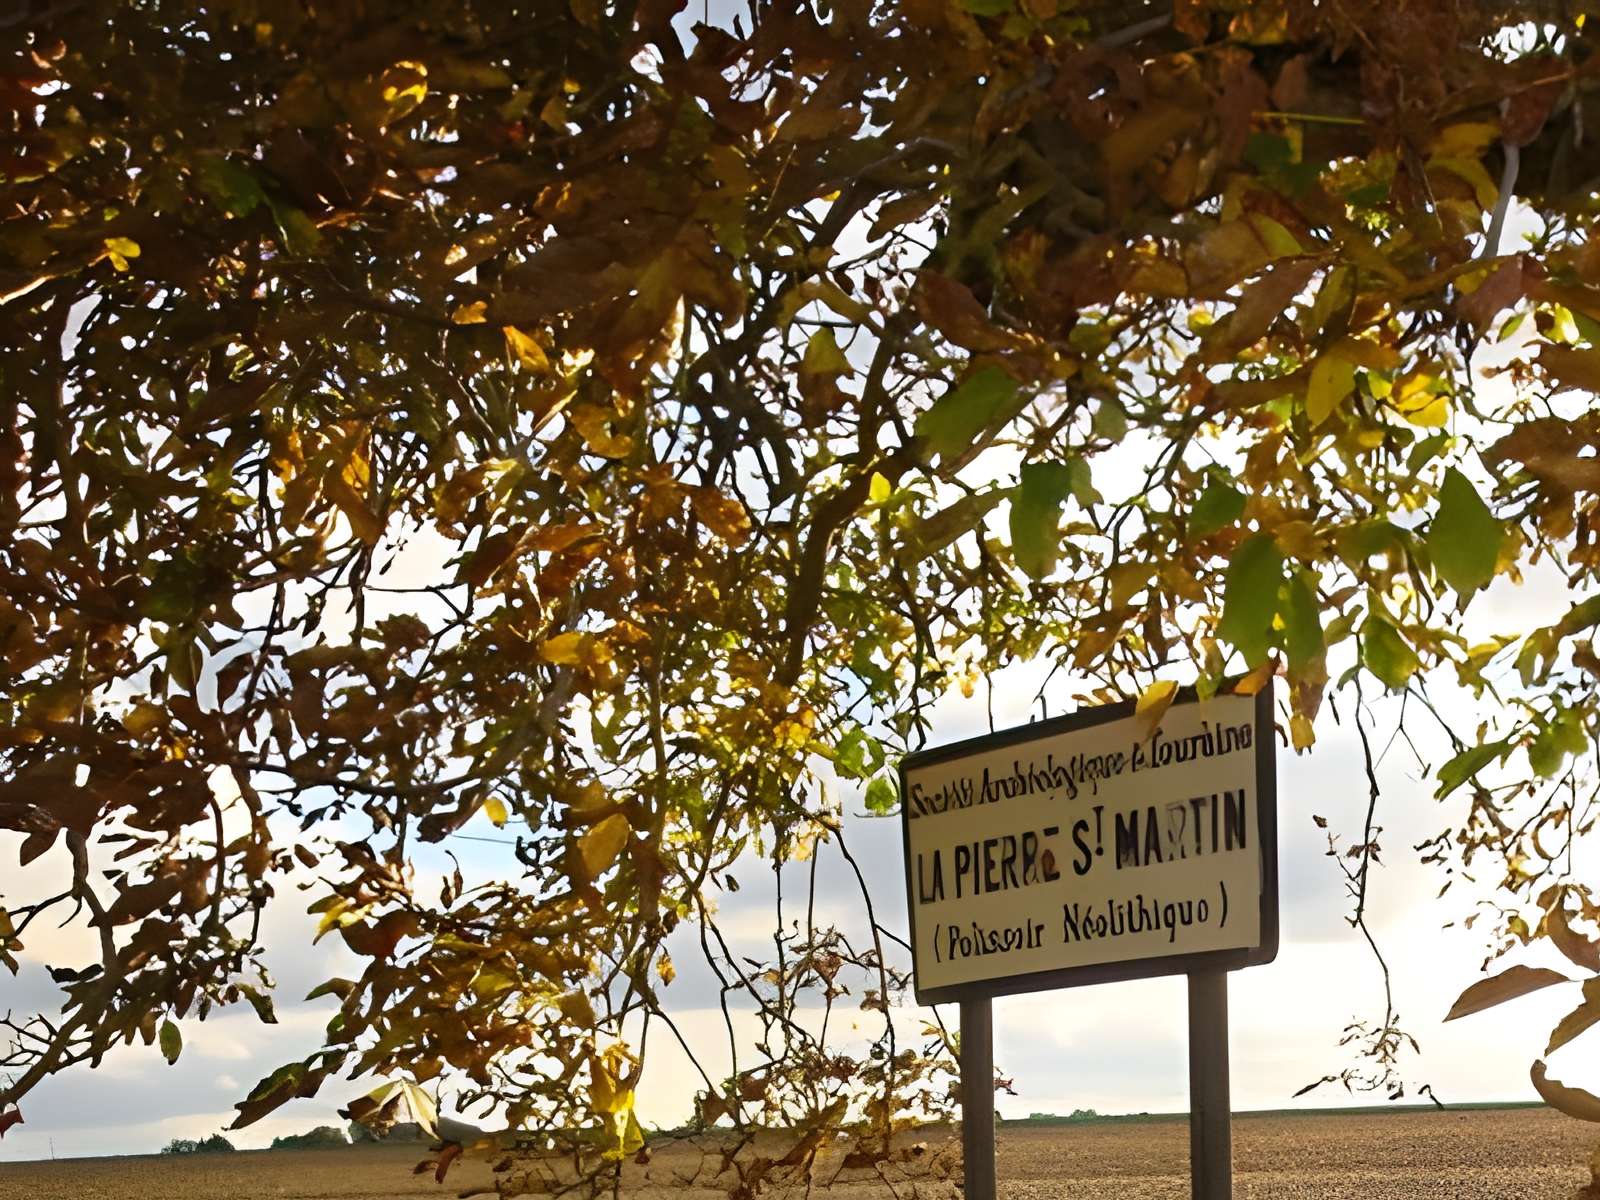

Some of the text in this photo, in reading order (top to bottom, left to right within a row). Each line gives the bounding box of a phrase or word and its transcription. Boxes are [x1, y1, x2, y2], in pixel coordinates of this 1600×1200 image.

[918, 849, 945, 905] LA
[954, 826, 1061, 899] PIERRE
[1115, 788, 1247, 870] MARTIN
